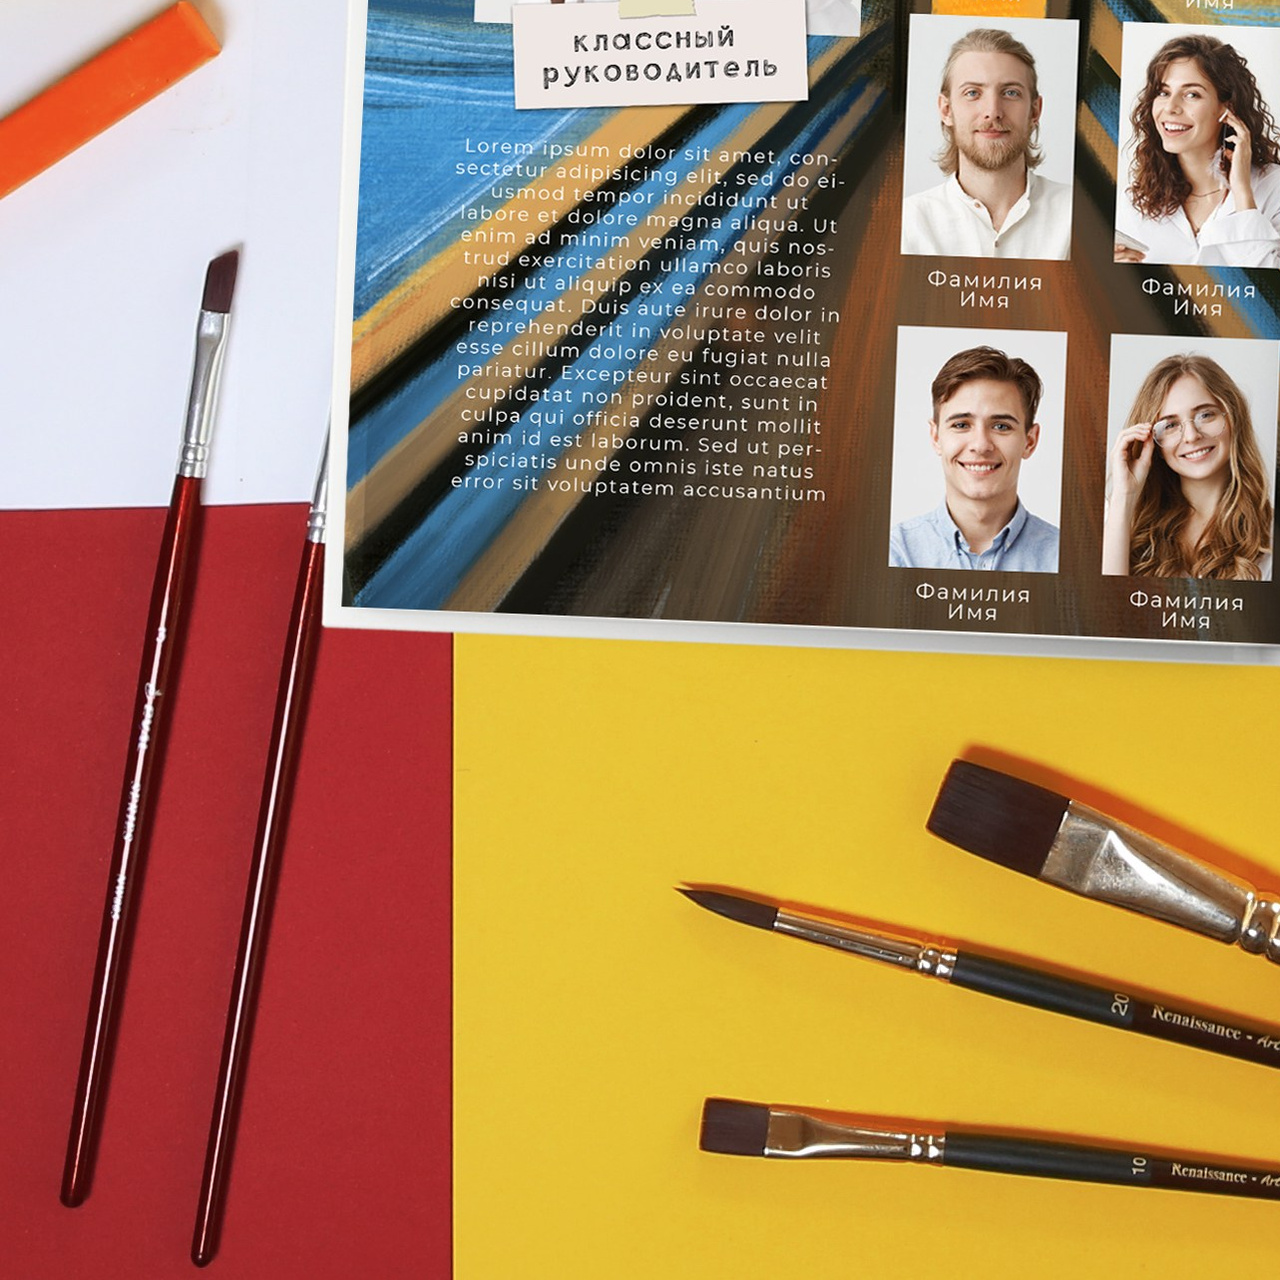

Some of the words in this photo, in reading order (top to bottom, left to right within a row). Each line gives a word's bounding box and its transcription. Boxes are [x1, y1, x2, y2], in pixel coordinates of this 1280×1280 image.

[573, 24, 735, 53] классный
[543, 58, 779, 90] руководитель
[465, 137, 534, 155] Lorem
[543, 139, 610, 160] ipsum
[618, 142, 676, 160] dolor
[684, 145, 711, 161] sit
[718, 149, 781, 167] amet,
[789, 153, 838, 166] con-
[455, 161, 548, 178] sectetur
[556, 163, 678, 187] adipisicing
[686, 167, 728, 188] elit,
[735, 170, 774, 187] sed
[782, 170, 810, 188] do
[817, 172, 845, 189] ei-
[490, 185, 565, 201] usmod
[573, 187, 655, 207] tempor
[663, 189, 778, 209] incididunt
[786, 195, 809, 210] ut
[460, 203, 529, 221] labore
[537, 208, 559, 223] et
[567, 207, 638, 226] dolore
[646, 215, 722, 232] magna
[730, 214, 804, 234] aliqua.
[813, 217, 838, 233] Ut
[460, 227, 516, 244] enim
[525, 229, 551, 245] ad
[560, 231, 630, 248] minim
[638, 234, 725, 255] veniam,
[733, 237, 780, 257] quis
[788, 243, 834, 255] nos-
[463, 250, 510, 266] trud
[518, 253, 651, 271] exercitation
[660, 256, 748, 275] ullamco
[757, 259, 831, 278] laboris
[477, 271, 515, 288] nisi
[524, 274, 546, 289] ut
[554, 274, 632, 296] aliquip
[639, 281, 663, 293] ex
[671, 282, 696, 295] ea
[704, 283, 816, 299] commodo
[927, 269, 1042, 291] Фамилия
[1141, 277, 1256, 299] Фамилия
[450, 297, 572, 316] consequat.
[581, 298, 630, 315] Duis
[637, 302, 686, 317] aute
[695, 302, 747, 320] irure
[754, 304, 812, 322] dolor
[821, 307, 840, 323] in
[959, 290, 1010, 309] Имя
[1173, 298, 1224, 317] Имя
[469, 318, 623, 337] reprehenderit
[632, 322, 651, 338] in
[659, 324, 766, 345] voluptate
[773, 328, 821, 344] velit
[456, 342, 504, 356] esse
[511, 341, 580, 358] cillum
[588, 343, 659, 361] dolore
[667, 350, 693, 363] eu
[702, 347, 768, 368] fugiat
[776, 351, 831, 368] nulla
[457, 362, 552, 380] pariatur.
[561, 364, 672, 386] Excepteur
[680, 369, 721, 386] sint
[729, 374, 828, 390] occaecat
[465, 384, 573, 404] cupidatat
[582, 391, 623, 404] non
[632, 390, 733, 411] proident,
[741, 395, 790, 410] sunt
[798, 395, 818, 411] in
[460, 406, 521, 427] culpa
[529, 409, 564, 428] qui
[572, 410, 640, 428] officia
[648, 412, 748, 432] deserunt
[757, 418, 821, 434] mollit
[457, 428, 512, 445] anim
[522, 430, 541, 446] id
[549, 433, 583, 448] est
[591, 432, 690, 451] laborum.
[698, 436, 738, 453] Sed
[747, 439, 770, 454] ut
[778, 443, 822, 459] per-
[464, 451, 557, 471] spiciatis
[565, 455, 621, 472] unde
[629, 458, 697, 475] omnis
[705, 459, 744, 476] iste
[752, 463, 814, 479] natus
[450, 476, 505, 490] error
[512, 475, 538, 491] sit
[546, 477, 674, 497] voluptatem
[683, 484, 826, 501] accusantium
[915, 582, 1030, 604] Фамилия
[1129, 590, 1244, 612] Фамилия
[947, 603, 998, 622] Имя
[1161, 611, 1212, 630] Имя
[1111, 993, 1130, 1017] 20
[1151, 1004, 1242, 1042] Renaissance
[1132, 1157, 1147, 1175] 10
[1171, 1162, 1248, 1184] Renaissance
